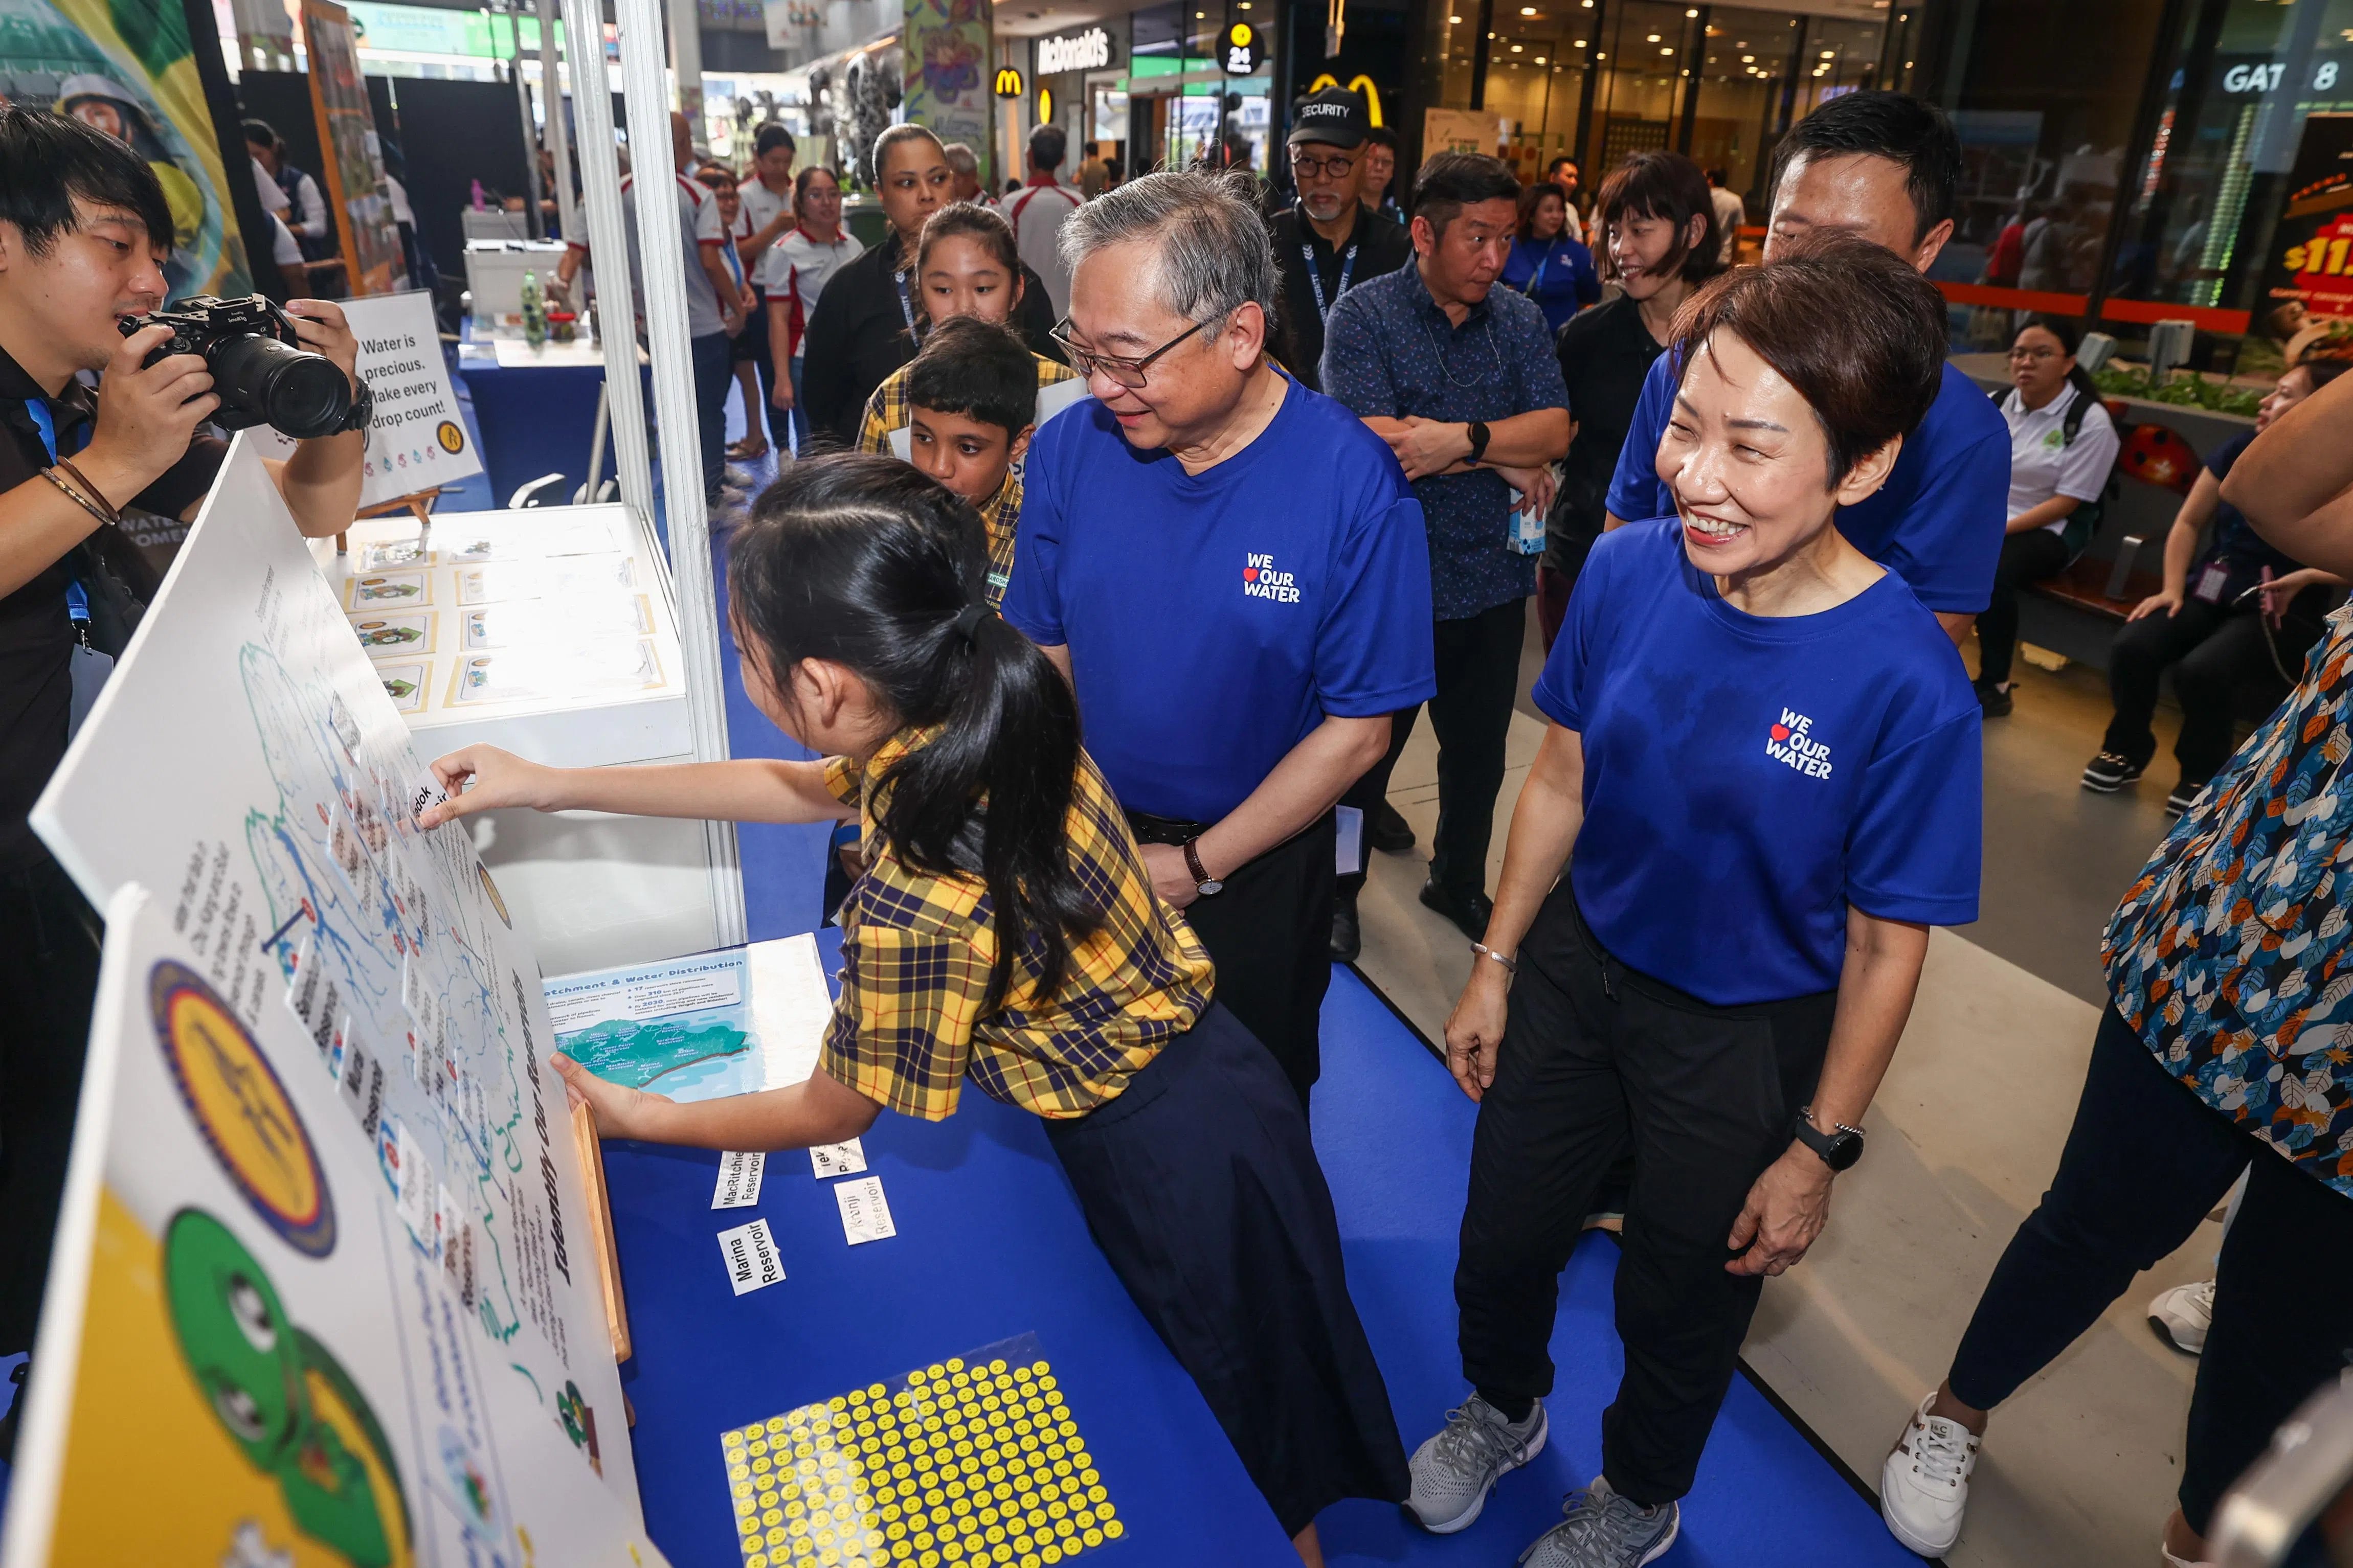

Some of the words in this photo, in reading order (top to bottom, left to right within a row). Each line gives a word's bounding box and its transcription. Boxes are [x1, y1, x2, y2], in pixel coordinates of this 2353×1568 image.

[1038, 27, 1108, 75] McDonald's
[1229, 47, 1251, 64] 24
[2223, 63, 2287, 93] GAT
[2313, 61, 2339, 90] 8
[1301, 103, 1350, 118] SECURITY
[362, 338, 401, 354] Water
[404, 335, 416, 348] is
[365, 359, 425, 382] precious.
[372, 389, 401, 404] ake
[404, 380, 437, 399] every
[372, 412, 403, 429] drop
[405, 400, 445, 421] count!
[1248, 552, 1273, 569] WE
[1244, 581, 1300, 603] WATER
[1260, 569, 1294, 586] OUR
[1780, 707, 1813, 735] WE
[1766, 737, 1832, 780] WATER
[1789, 733, 1831, 761] OUR
[413, 786, 432, 819] edok
[544, 981, 607, 996] atchment
[625, 972, 664, 983] Water
[668, 960, 743, 976] Distribution
[512, 967, 541, 1095] Reservoirs
[606, 1060, 636, 1069] MacRitchie
[532, 1089, 550, 1147] Our
[723, 1150, 744, 1206] MacRitchie
[742, 1152, 761, 1200] Reservoir
[541, 1144, 571, 1288] Identify
[864, 1181, 889, 1235] Reservoir
[731, 1238, 753, 1283] Marina
[747, 1223, 778, 1284] Reservoir
